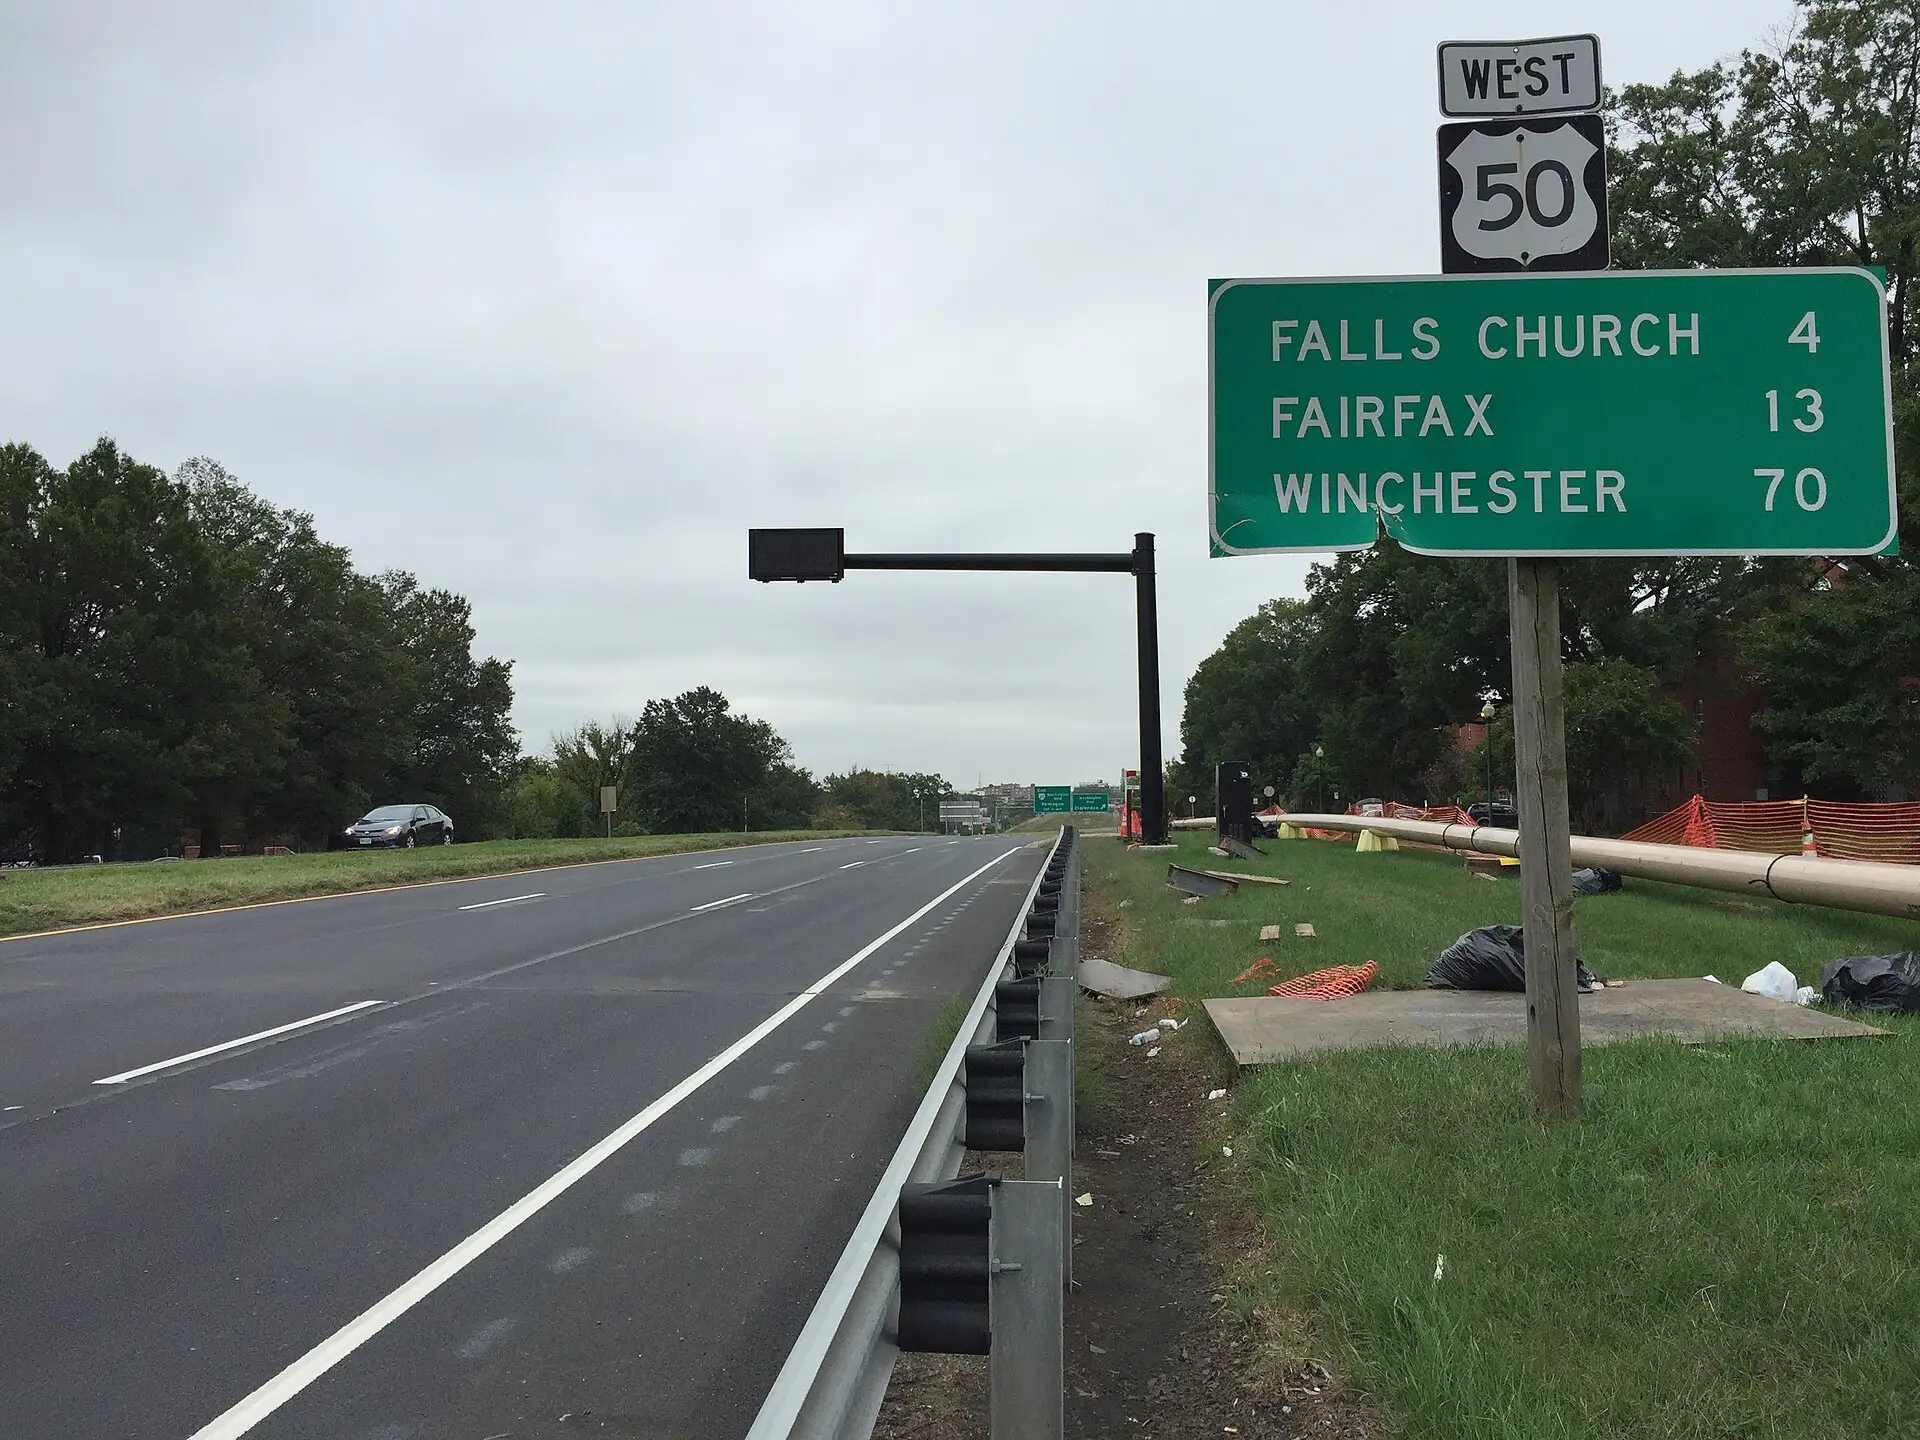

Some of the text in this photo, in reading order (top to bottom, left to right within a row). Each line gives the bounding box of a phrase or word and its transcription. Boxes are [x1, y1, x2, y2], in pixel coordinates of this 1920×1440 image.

[1461, 53, 1575, 99] WEST
[1477, 159, 1575, 231] 50
[1272, 312, 1820, 361] FALLS CHURCH 4
[1272, 389, 1823, 438] FAIRFAX 13
[1273, 468, 1826, 514] WINCHESTER 70
